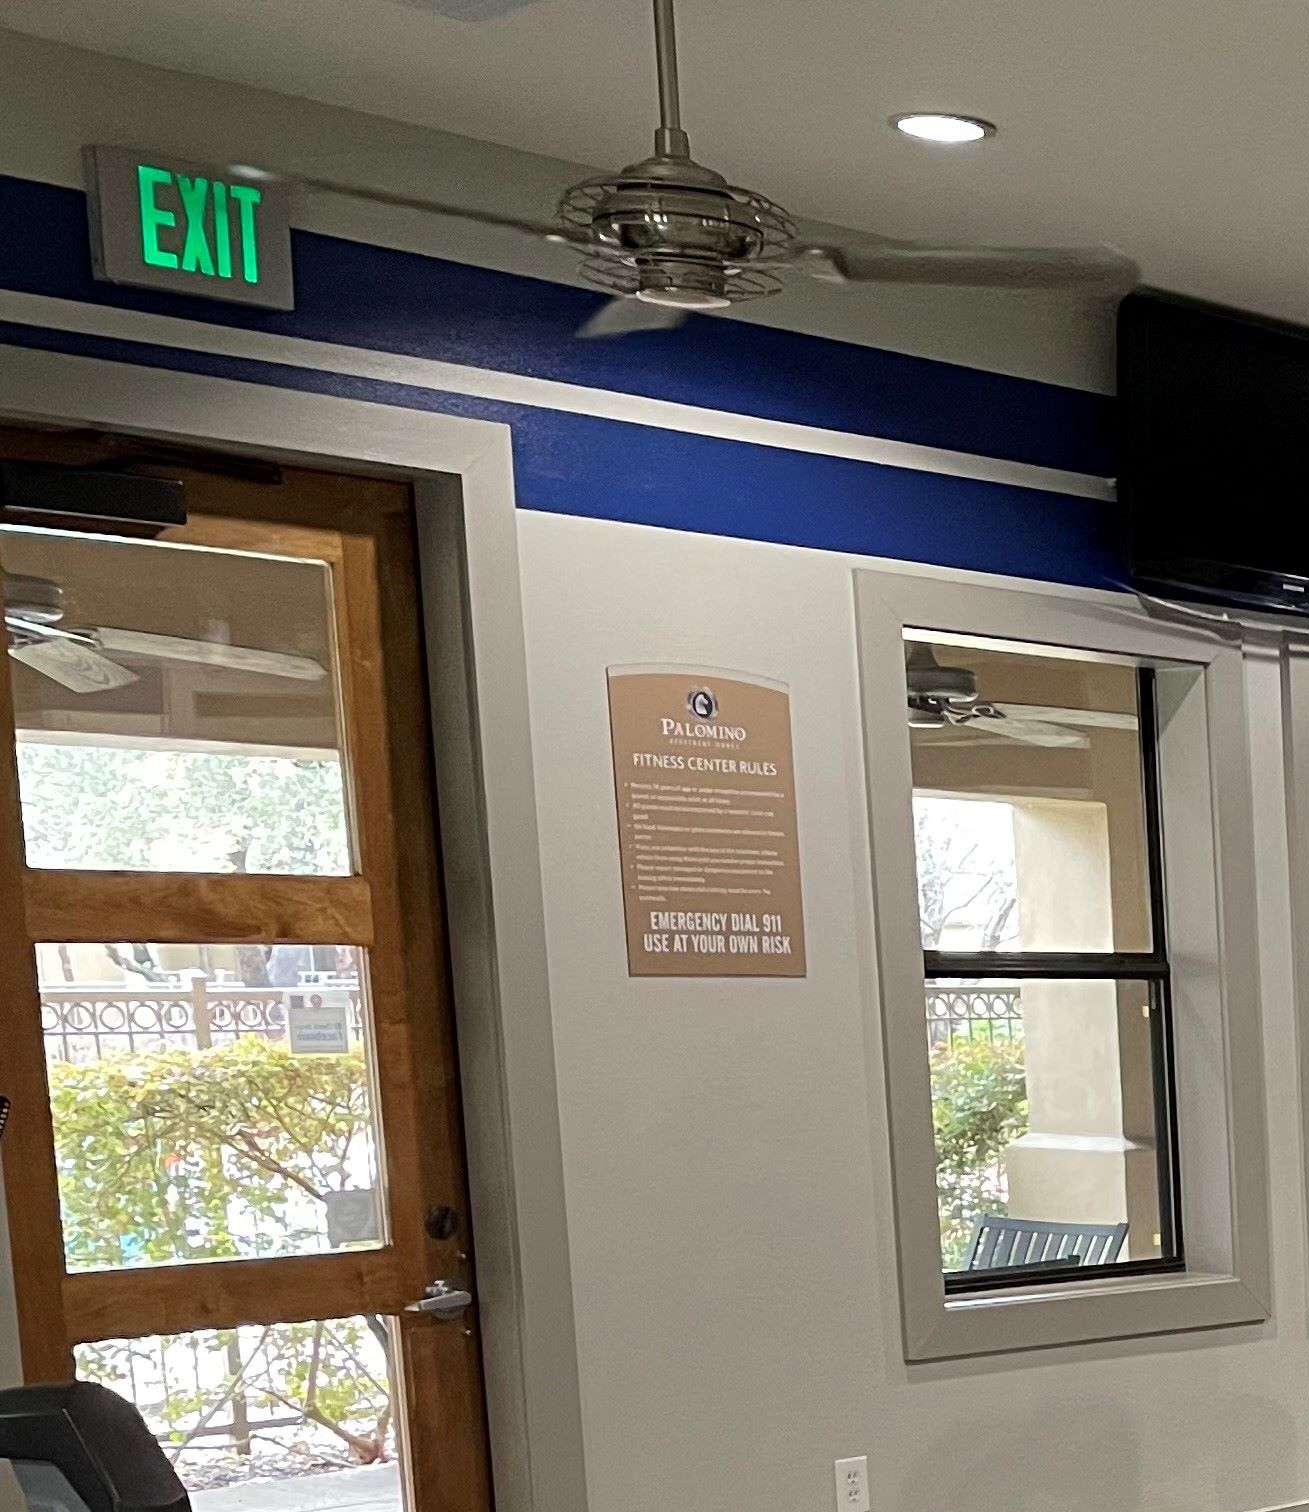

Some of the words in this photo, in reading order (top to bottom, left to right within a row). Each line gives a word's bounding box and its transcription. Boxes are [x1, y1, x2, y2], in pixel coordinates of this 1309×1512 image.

[137, 165, 262, 284] EXIT
[660, 718, 747, 741] PALOMINO
[632, 753, 685, 770] FITNESS
[687, 757, 737, 773] CENTER
[740, 761, 777, 776] RULES
[650, 911, 728, 931] EMERGENCY
[731, 913, 760, 932] DIAL
[763, 914, 782, 933] 911
[643, 933, 669, 952] USE
[673, 934, 688, 952] AT
[691, 934, 726, 953] YOUR
[729, 935, 758, 953] OWN
[762, 936, 792, 954] RISK
